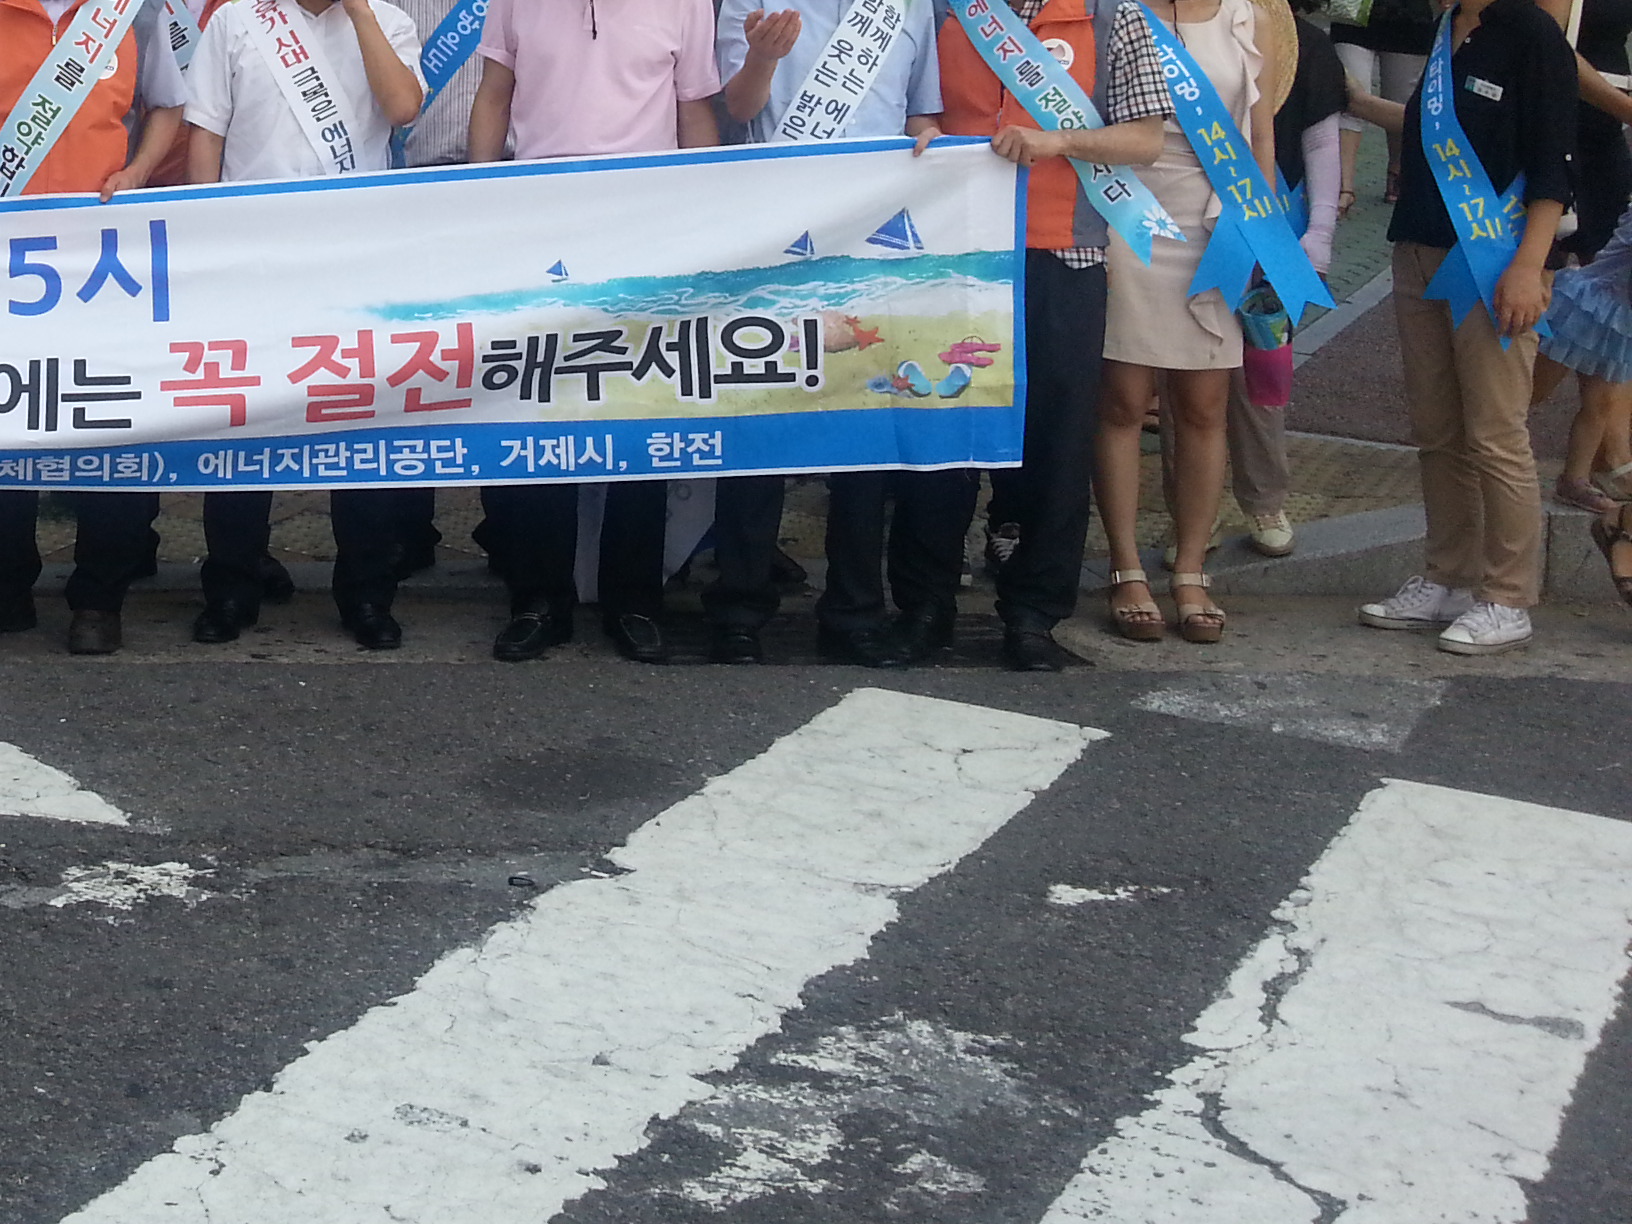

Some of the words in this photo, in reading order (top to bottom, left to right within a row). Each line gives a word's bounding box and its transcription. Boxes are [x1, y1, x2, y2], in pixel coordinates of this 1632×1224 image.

[275, 28, 310, 69] 시대
[814, 39, 855, 88] 웃는
[291, 65, 338, 123] 극복은
[781, 89, 824, 141] 밝은
[321, 119, 356, 175] 에너지
[158, 337, 262, 428] 꼭
[286, 314, 826, 427] 절전해주세요!
[196, 436, 481, 480] 에너지관리공단,
[499, 433, 629, 473] 거제시,
[646, 429, 724, 468] 한전
